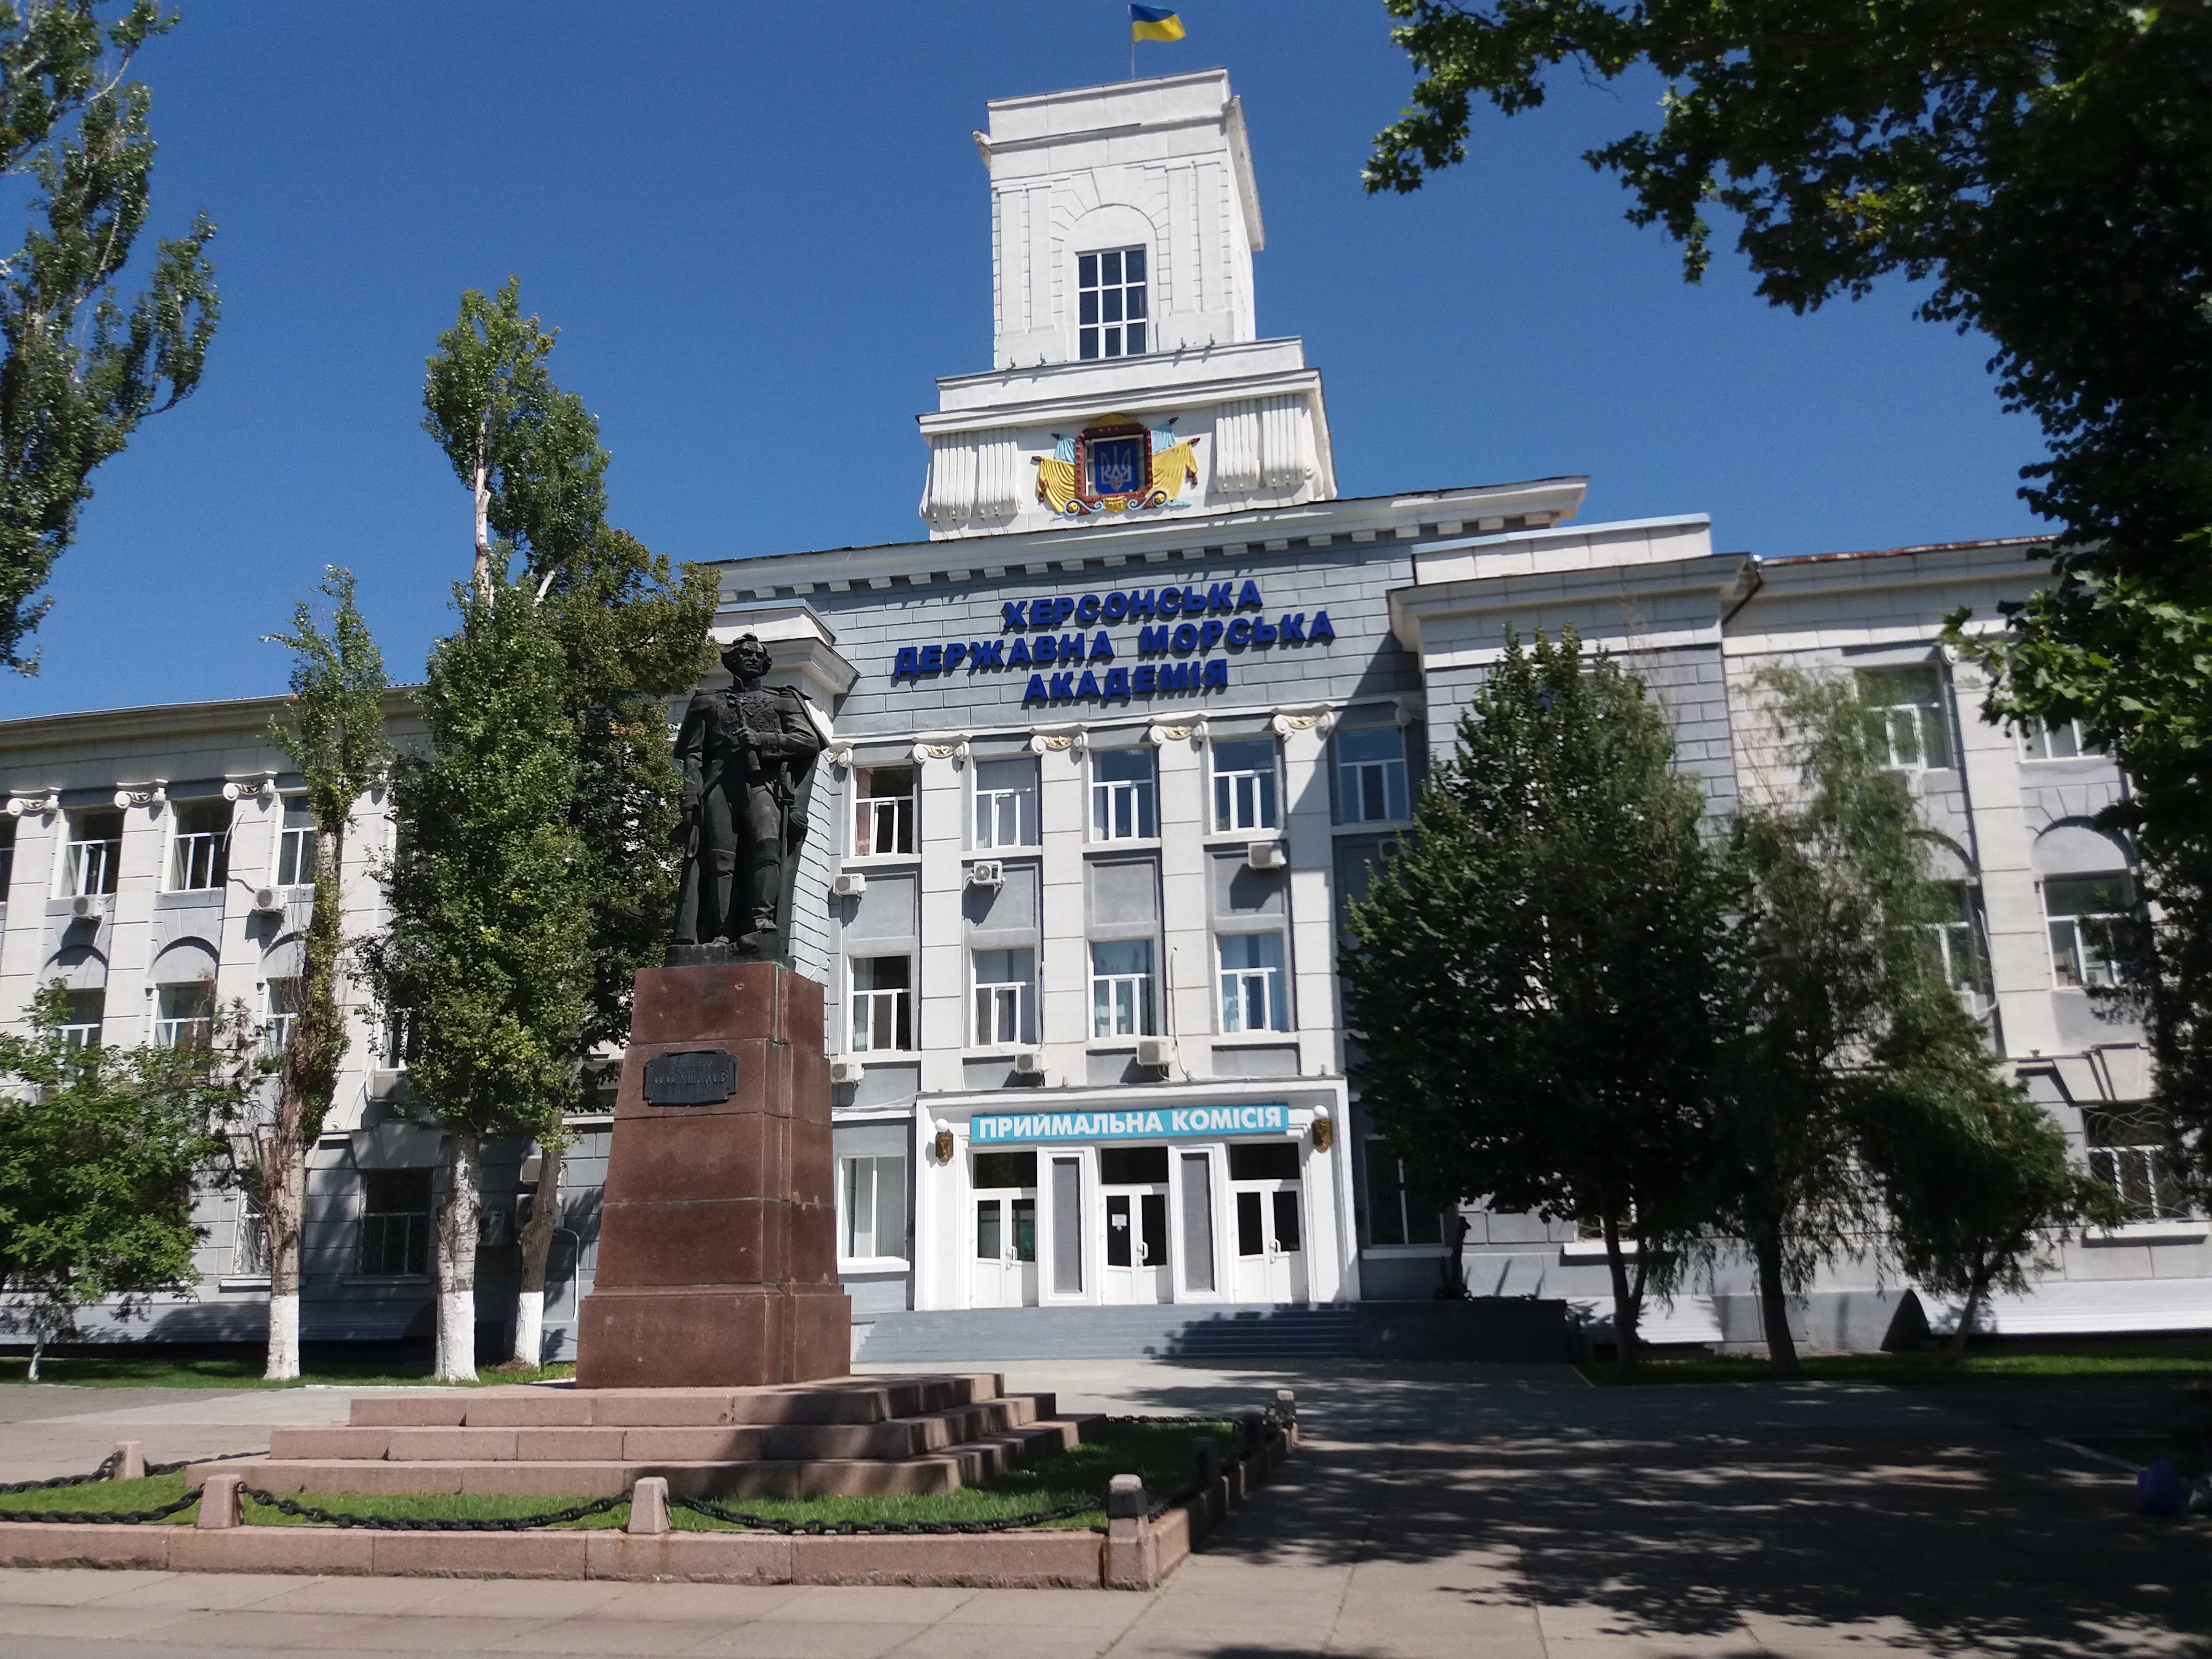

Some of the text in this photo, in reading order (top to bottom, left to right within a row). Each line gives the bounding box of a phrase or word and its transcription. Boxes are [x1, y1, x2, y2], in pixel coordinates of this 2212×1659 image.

[1003, 580, 1263, 627] ХЕРСОНСЬКА
[893, 611, 1335, 678] ДЕРЖАВНА МОРСЬКА
[1023, 659, 1228, 701] АКАДЕМІЯ
[980, 1107, 1281, 1139] ПРИЙМАЛЬНА КОМІСІЯ
